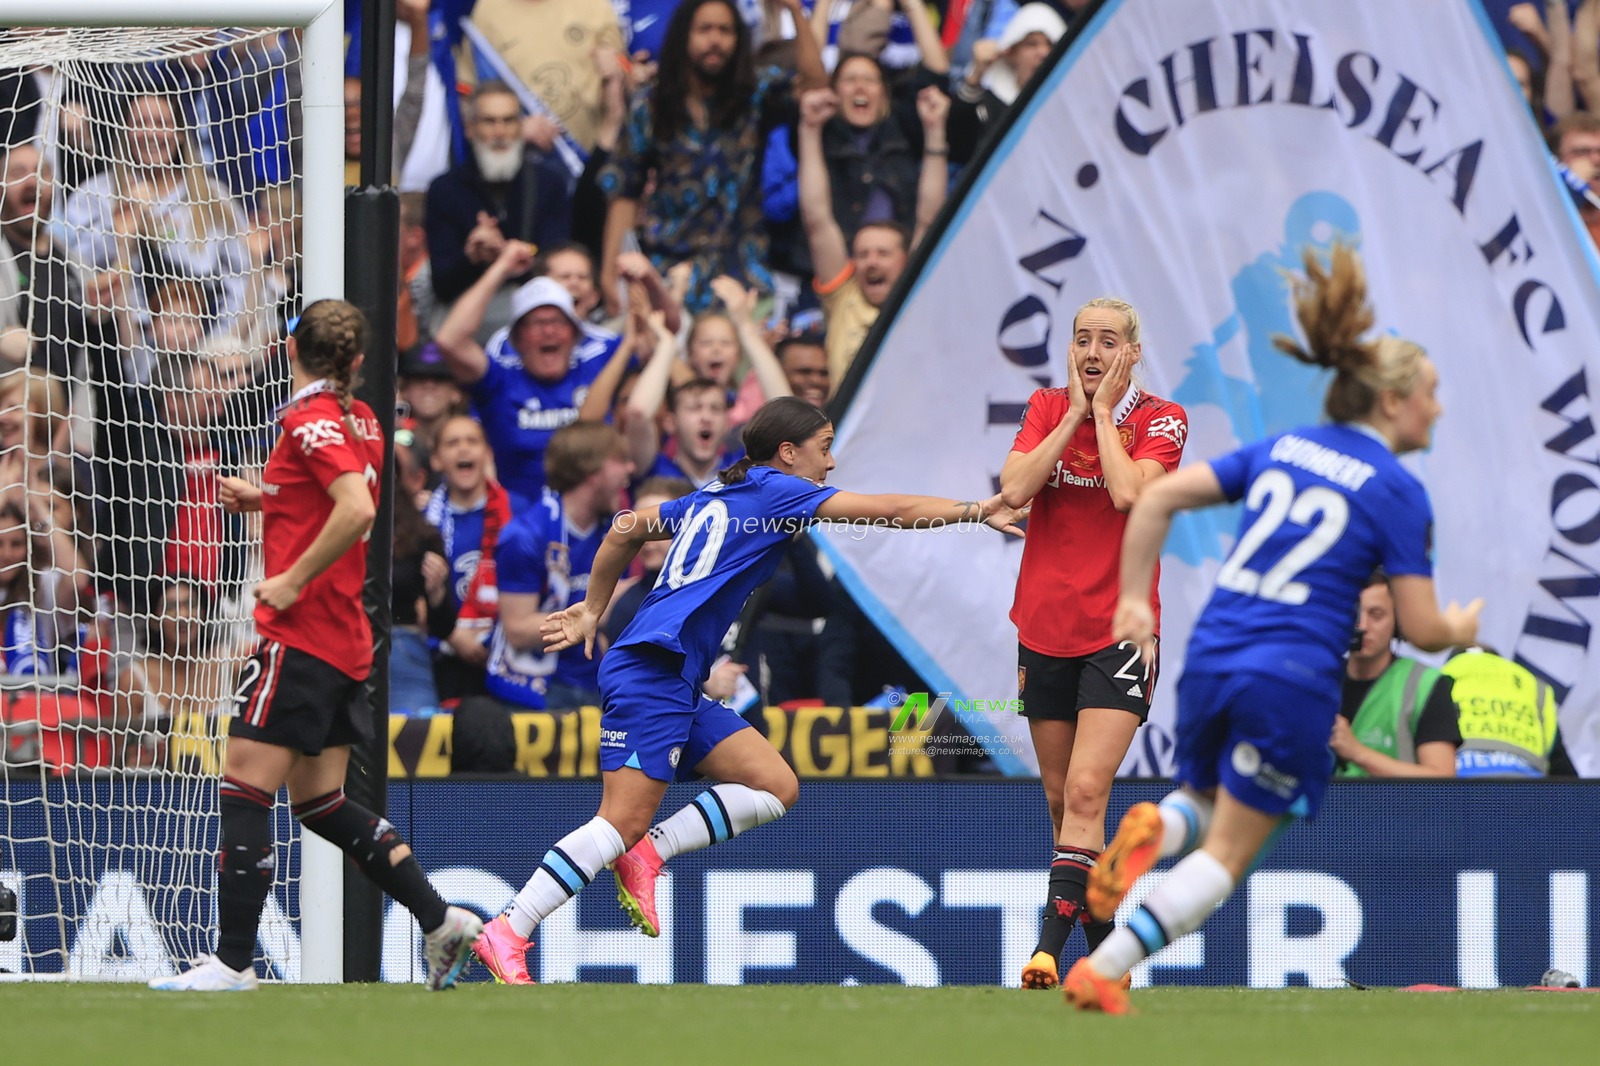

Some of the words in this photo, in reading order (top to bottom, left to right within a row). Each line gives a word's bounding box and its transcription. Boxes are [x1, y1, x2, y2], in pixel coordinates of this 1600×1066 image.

[1114, 29, 1484, 217] CHELSEA
[1477, 214, 1566, 351] FC
[1269, 434, 1377, 492] CUTHBERT
[652, 499, 729, 591] 10
[1217, 468, 1350, 606] 22
[235, 659, 261, 703] 2
[1464, 721, 1538, 746] EARCH
